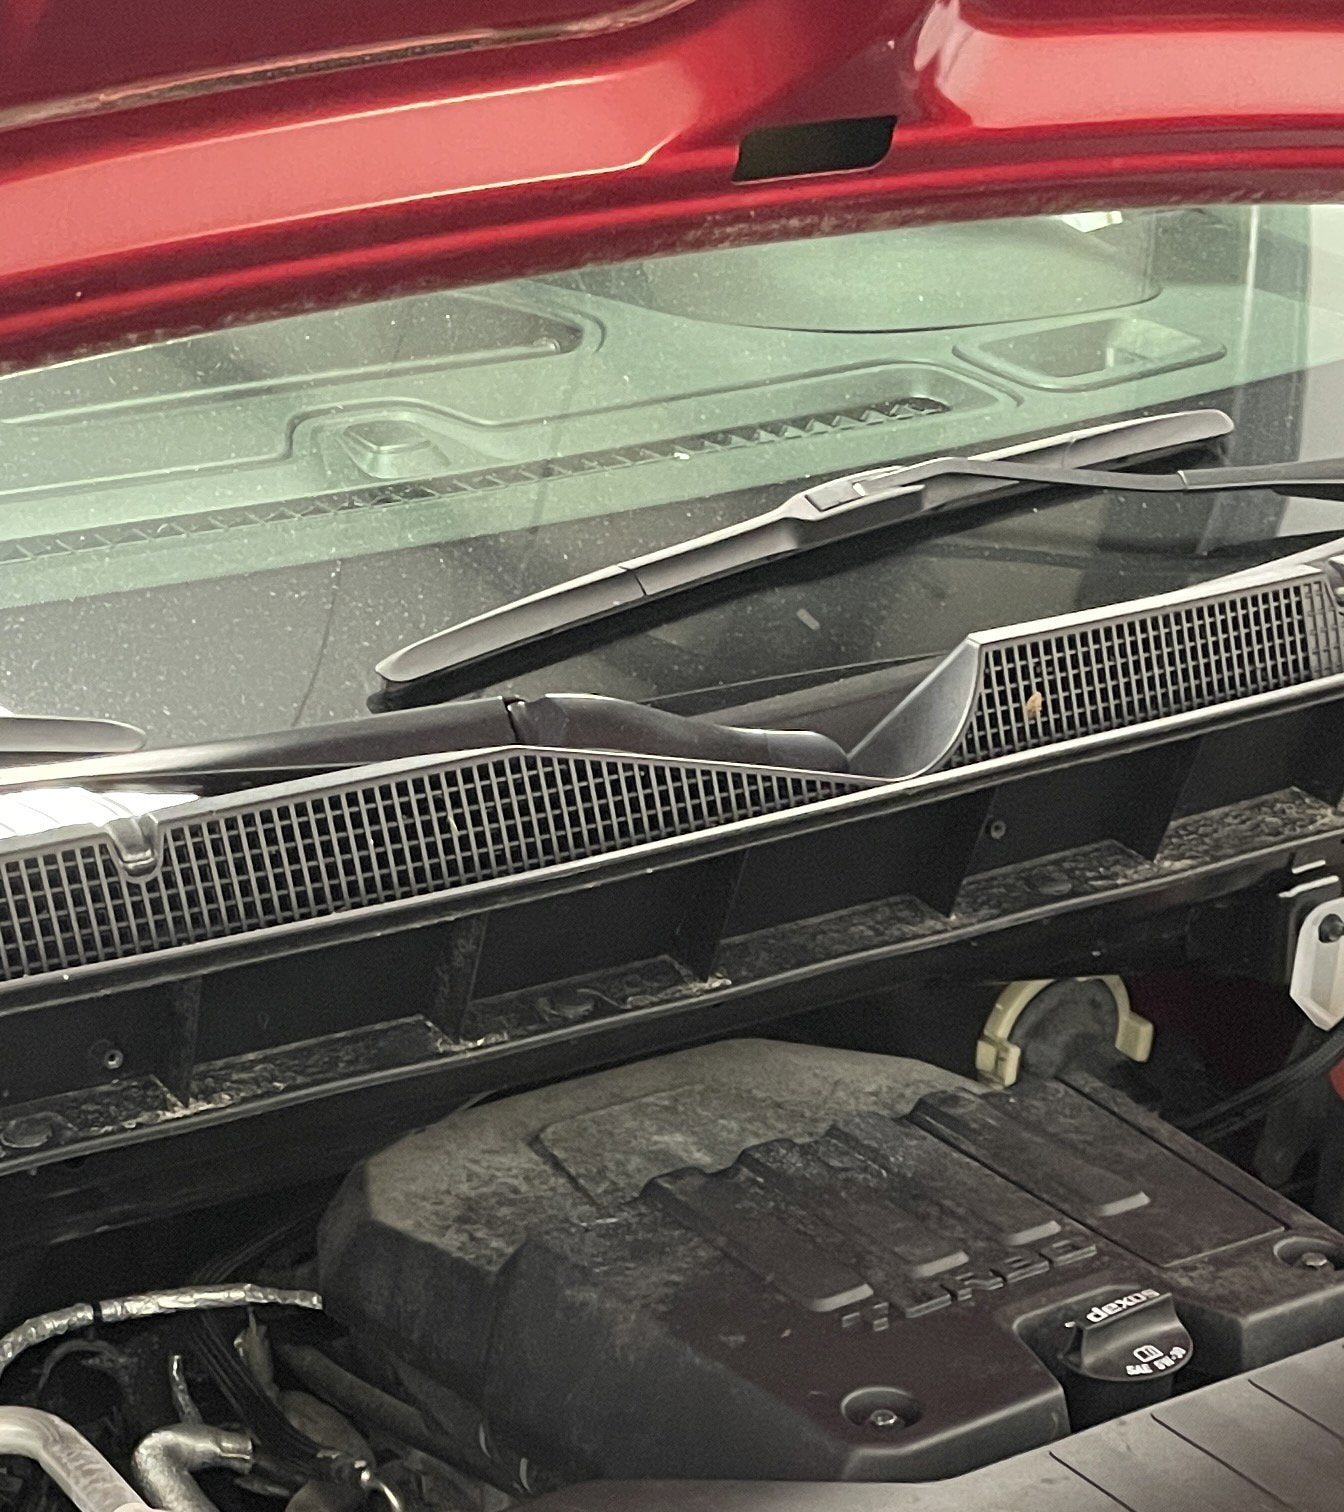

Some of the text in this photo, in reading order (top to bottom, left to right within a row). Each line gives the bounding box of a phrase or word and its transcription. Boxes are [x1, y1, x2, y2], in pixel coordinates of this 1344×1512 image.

[840, 1236, 1097, 1332] TURBO
[1086, 1288, 1160, 1323] dexos
[1126, 1363, 1154, 1376] SAE
